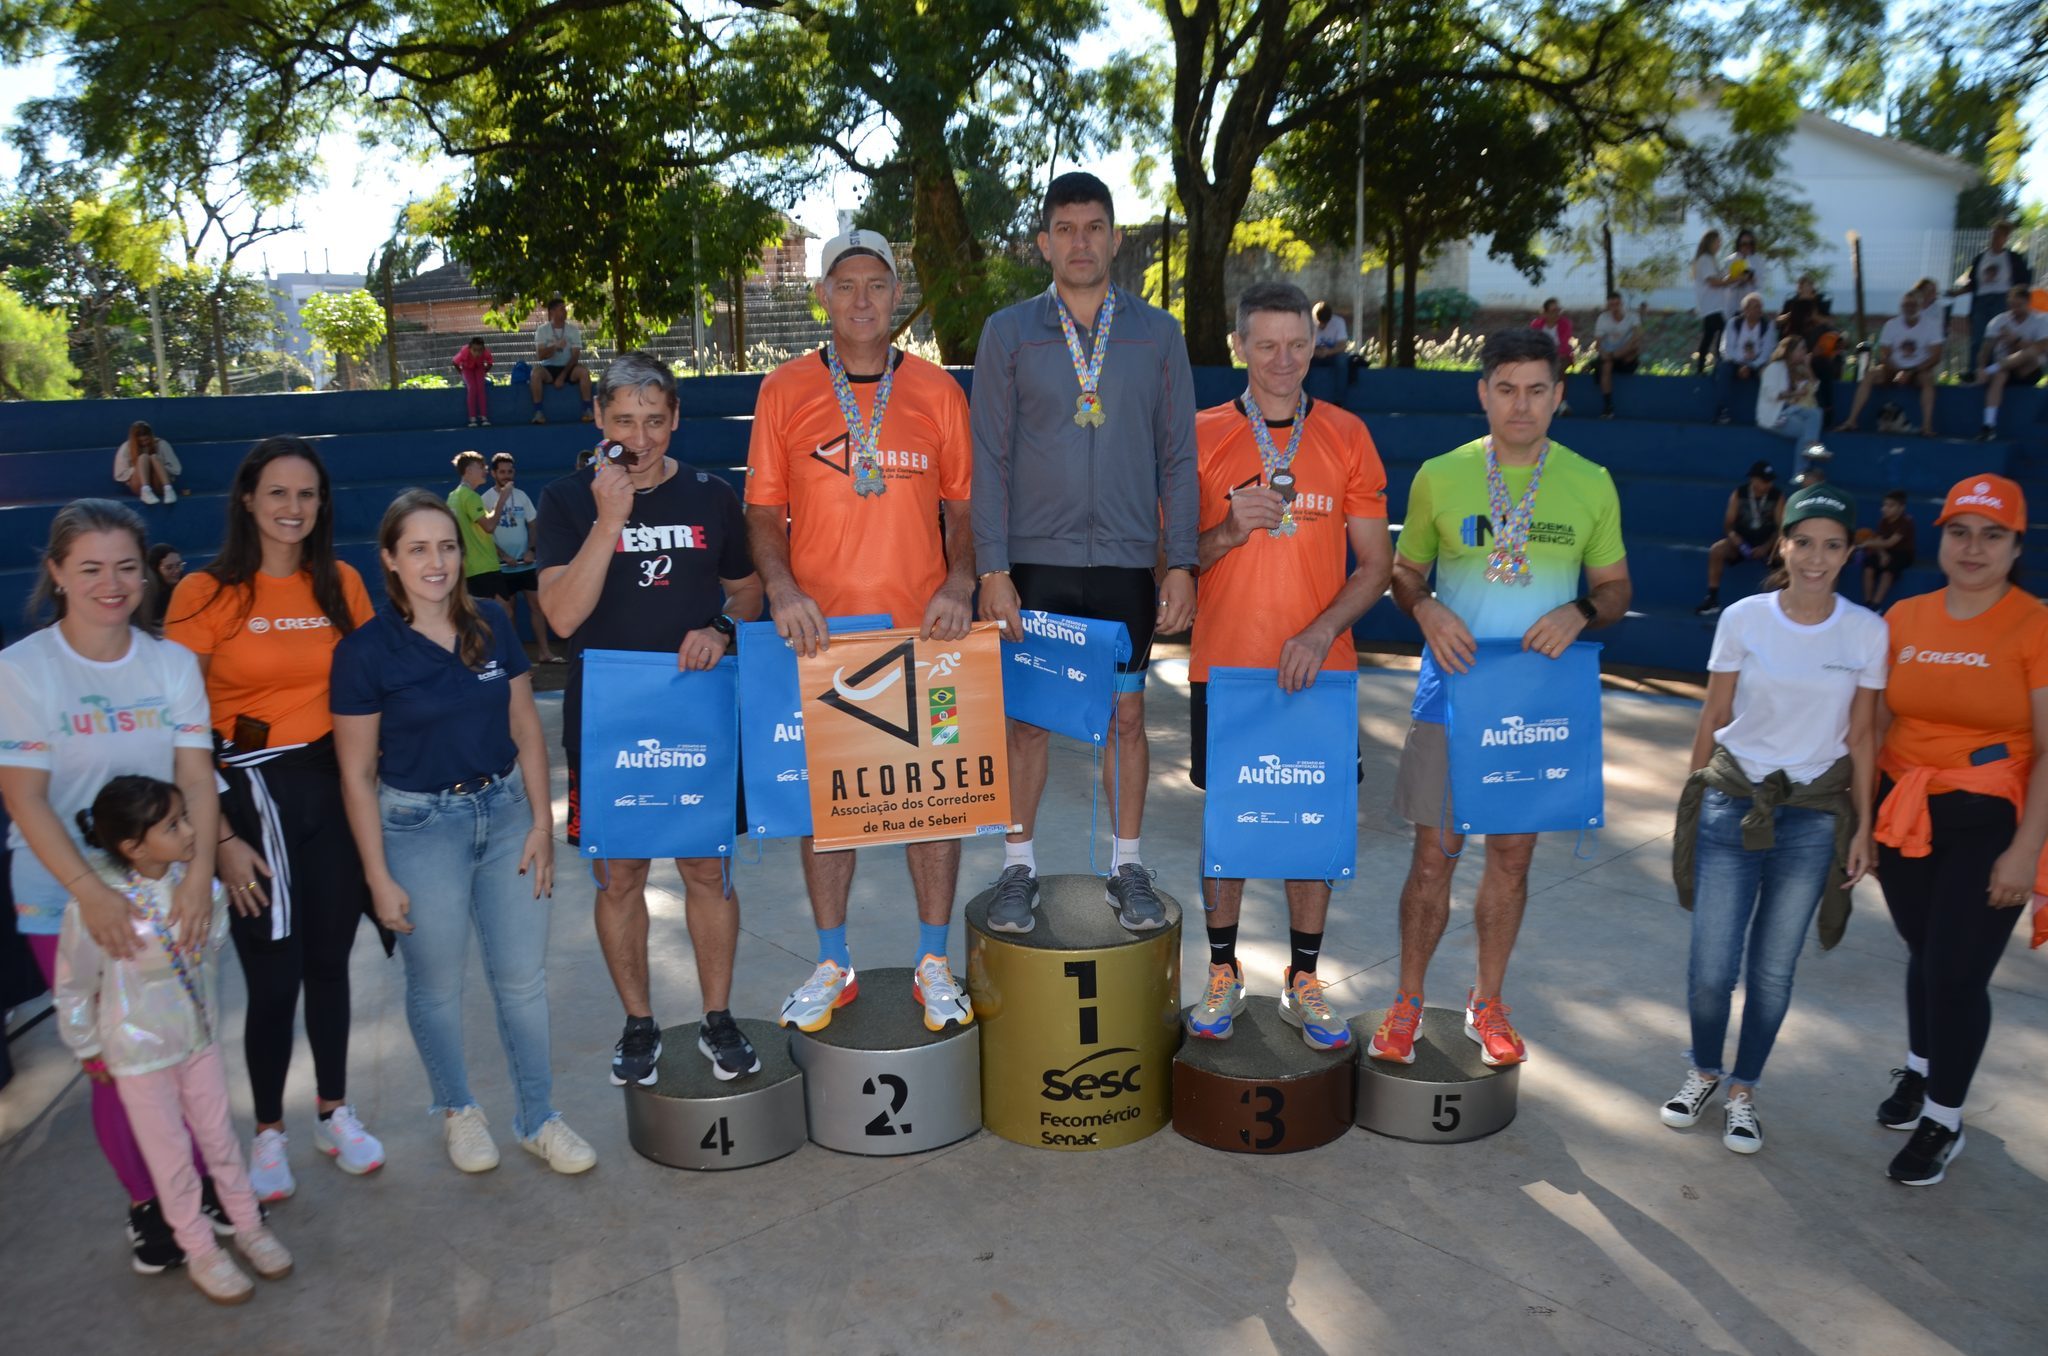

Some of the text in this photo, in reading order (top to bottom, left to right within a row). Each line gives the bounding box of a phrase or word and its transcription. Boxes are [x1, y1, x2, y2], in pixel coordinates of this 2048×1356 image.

[852, 450, 928, 469] AORSEB
[1295, 492, 1334, 512] RSEB
[639, 555, 672, 587] 30
[274, 616, 331, 630] CRESO
[1022, 617, 1086, 646] utismo
[1916, 650, 1990, 668] CRESOL
[1481, 725, 1570, 746] Autismo
[615, 750, 707, 769] Autismo
[832, 755, 994, 801] ACORSEB
[1238, 766, 1326, 785] Autismo
[831, 792, 996, 816] Associação dos Corredores
[863, 812, 967, 833] de Rua de Seberi
[1064, 960, 1098, 1045] 1
[862, 1074, 912, 1136] 2
[1040, 1105, 1141, 1127] Fecomércio
[1432, 1094, 1461, 1132] 5
[1240, 1086, 1286, 1149] 3
[700, 1116, 734, 1156] 4
[1042, 1131, 1097, 1146] Senac
